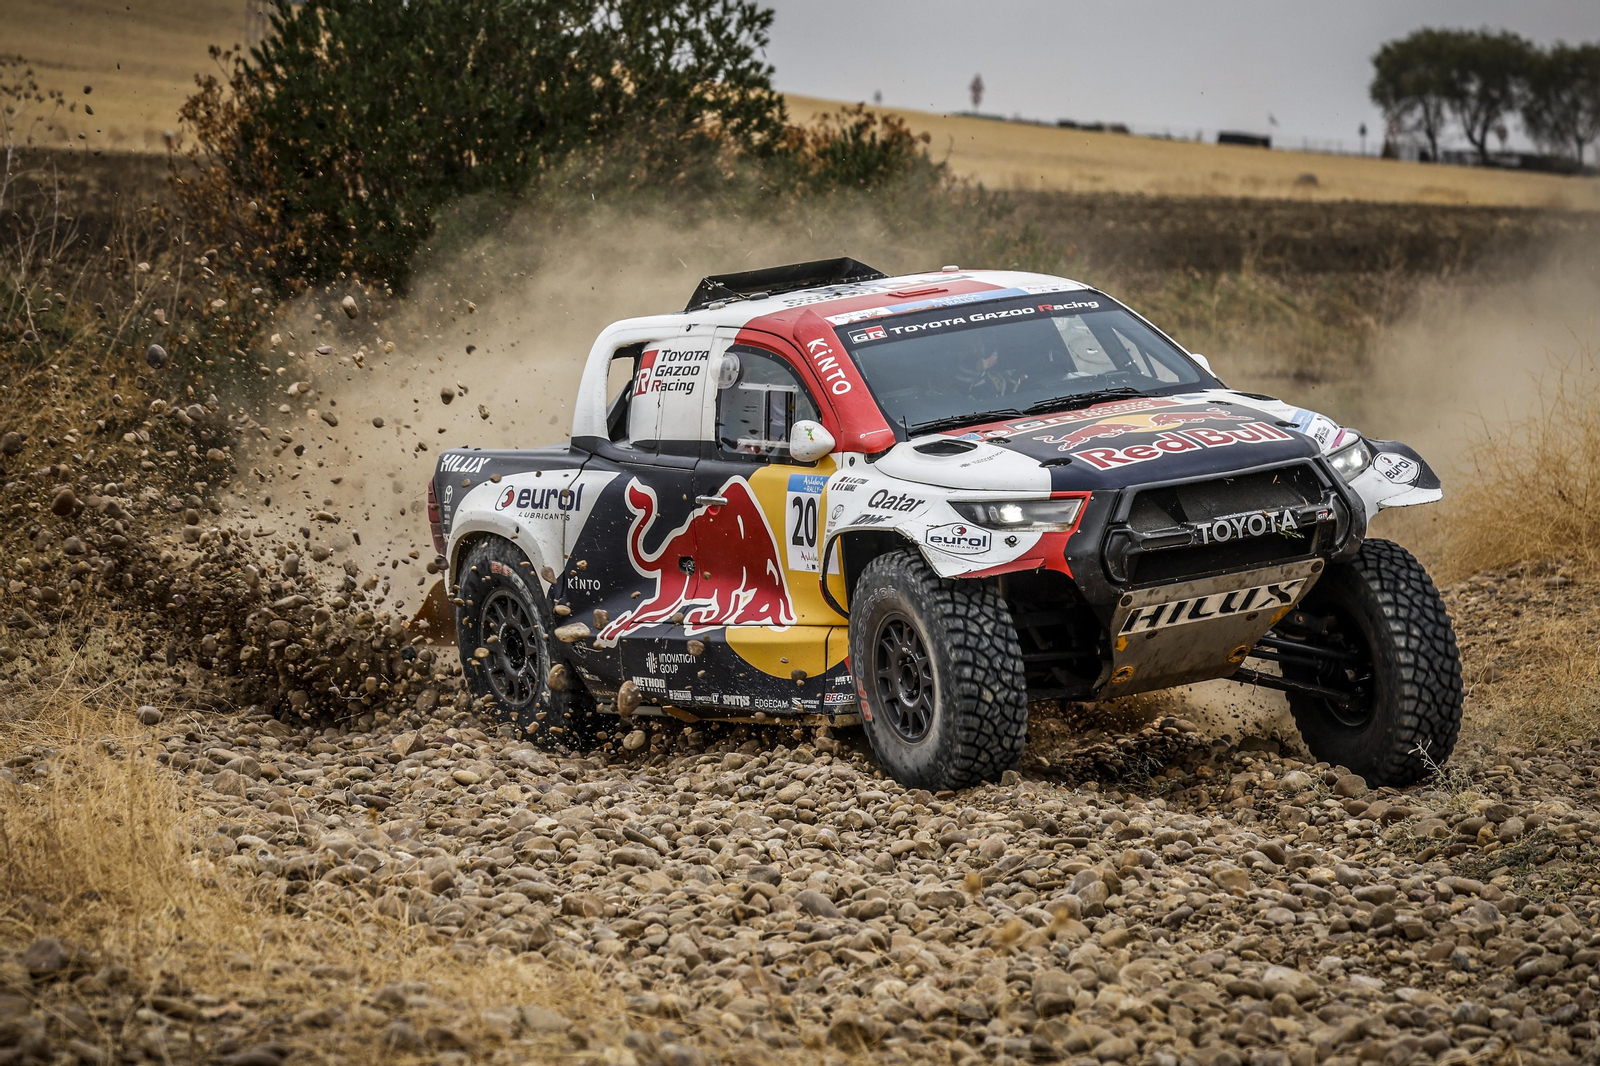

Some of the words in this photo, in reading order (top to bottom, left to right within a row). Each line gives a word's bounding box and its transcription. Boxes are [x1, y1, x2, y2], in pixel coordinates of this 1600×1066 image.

[890, 317, 966, 334] TOYOTA
[970, 306, 1035, 322] GAZOO
[1037, 300, 1100, 312] Racing
[852, 330, 887, 343] GR
[661, 349, 710, 362] TOYOTA
[655, 365, 700, 377] GAZOO
[651, 379, 695, 395] Racing
[1071, 431, 1202, 470] Red
[1178, 421, 1295, 448] Bull
[440, 454, 491, 473] HILUX
[1385, 458, 1412, 479] eurol
[516, 483, 585, 511] eurol
[868, 489, 926, 512] Qatar
[518, 511, 570, 521] LUBRICANTS
[792, 496, 817, 547] 20
[1197, 509, 1298, 544] TOYOTA
[930, 535, 986, 547] eurol
[1121, 580, 1304, 633] HILUX
[632, 676, 666, 689] METHOD
